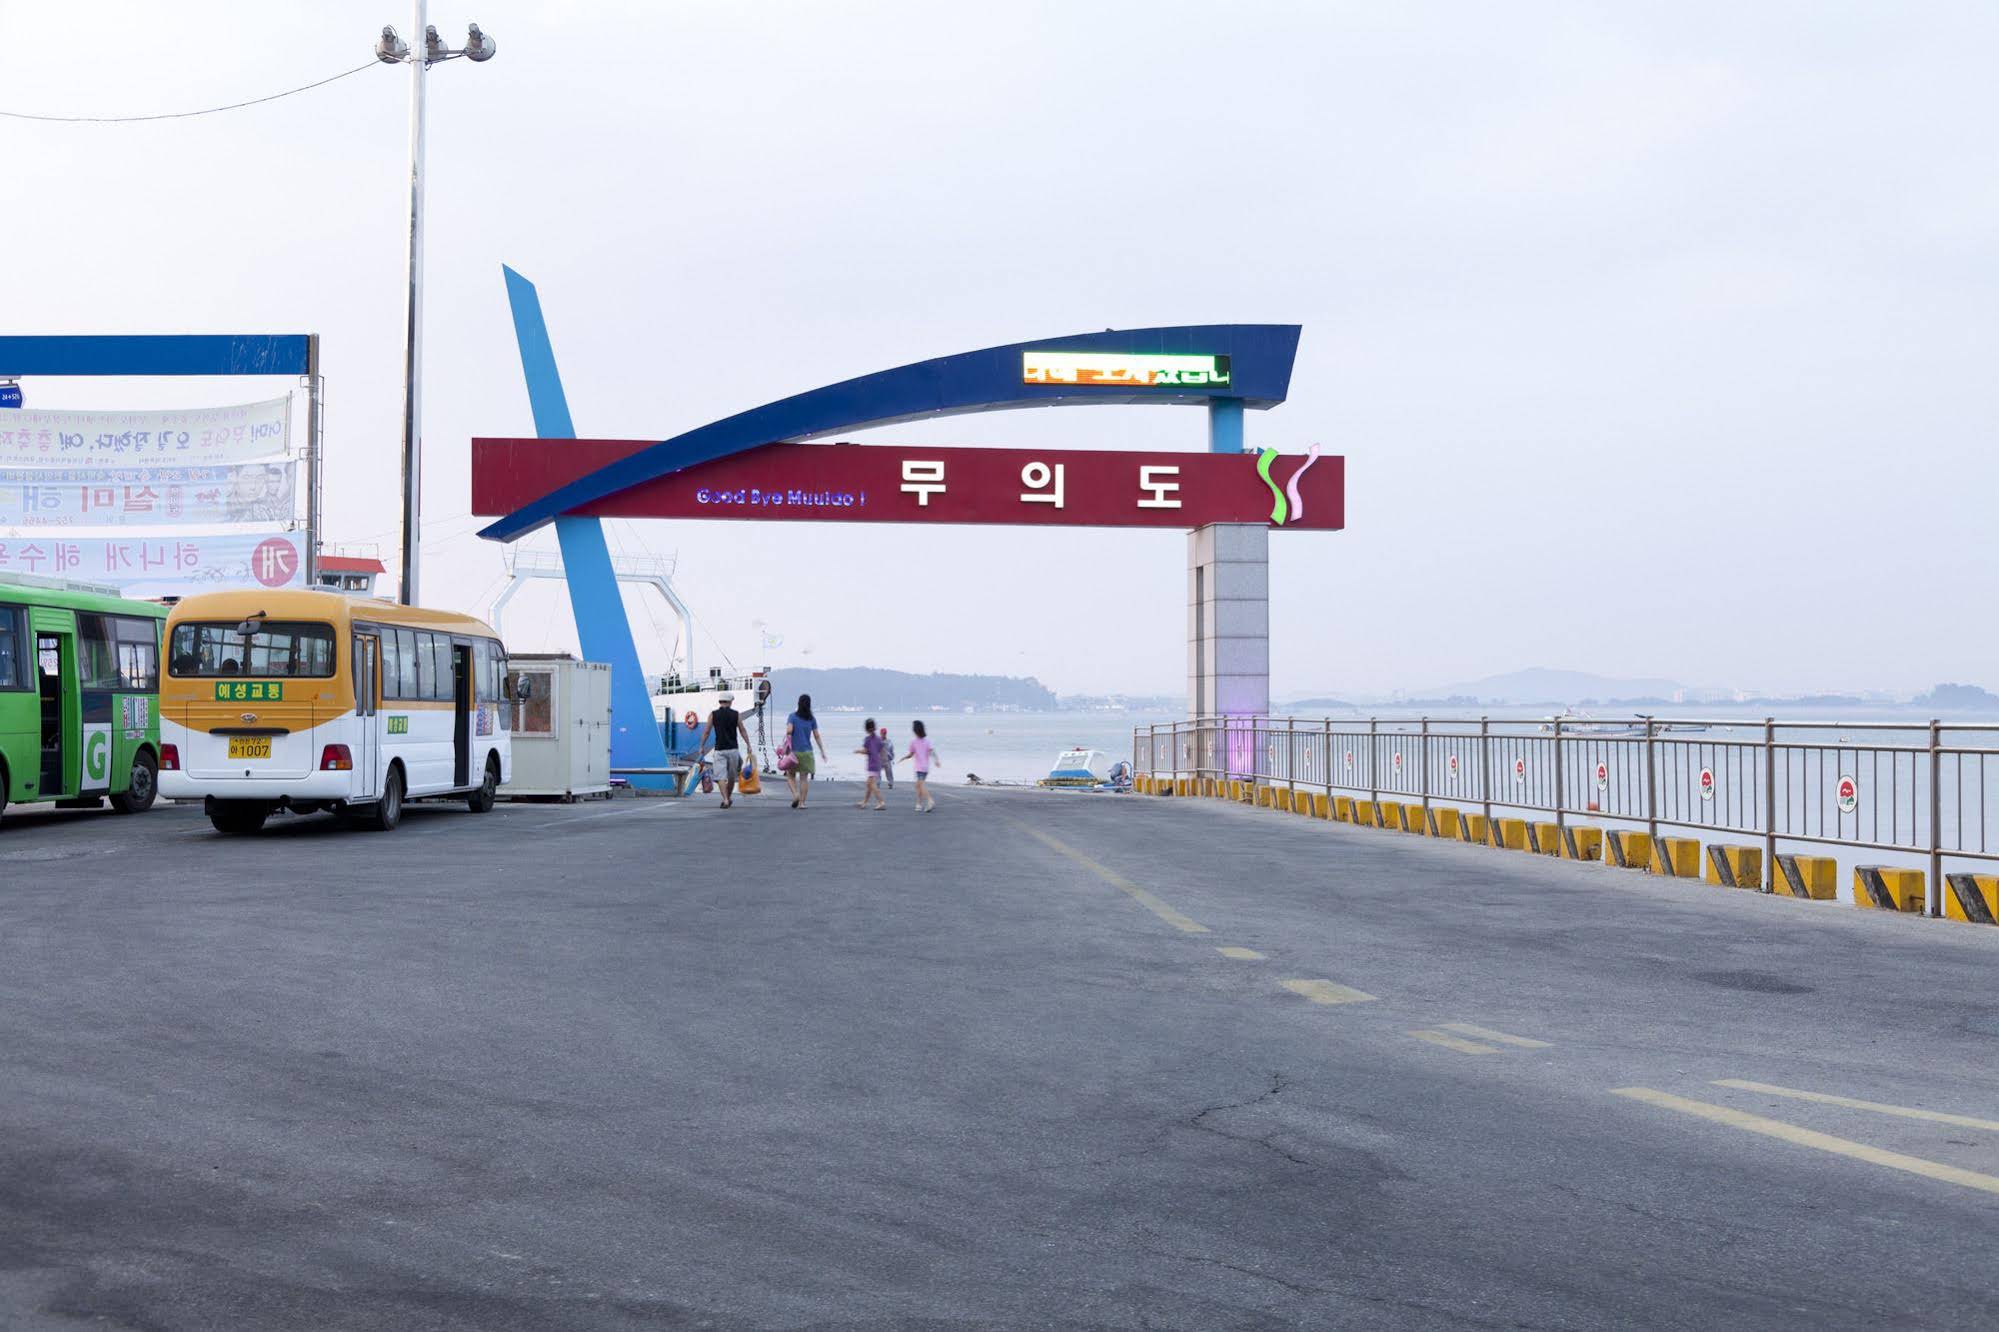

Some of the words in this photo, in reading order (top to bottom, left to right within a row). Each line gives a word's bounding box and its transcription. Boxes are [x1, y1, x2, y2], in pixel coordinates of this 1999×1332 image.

[697, 488, 746, 505] Good
[751, 489, 784, 507] Bye
[787, 489, 855, 507] Muuido
[218, 683, 279, 699] 예성교통
[87, 731, 106, 781] G
[240, 744, 269, 757] 1007
